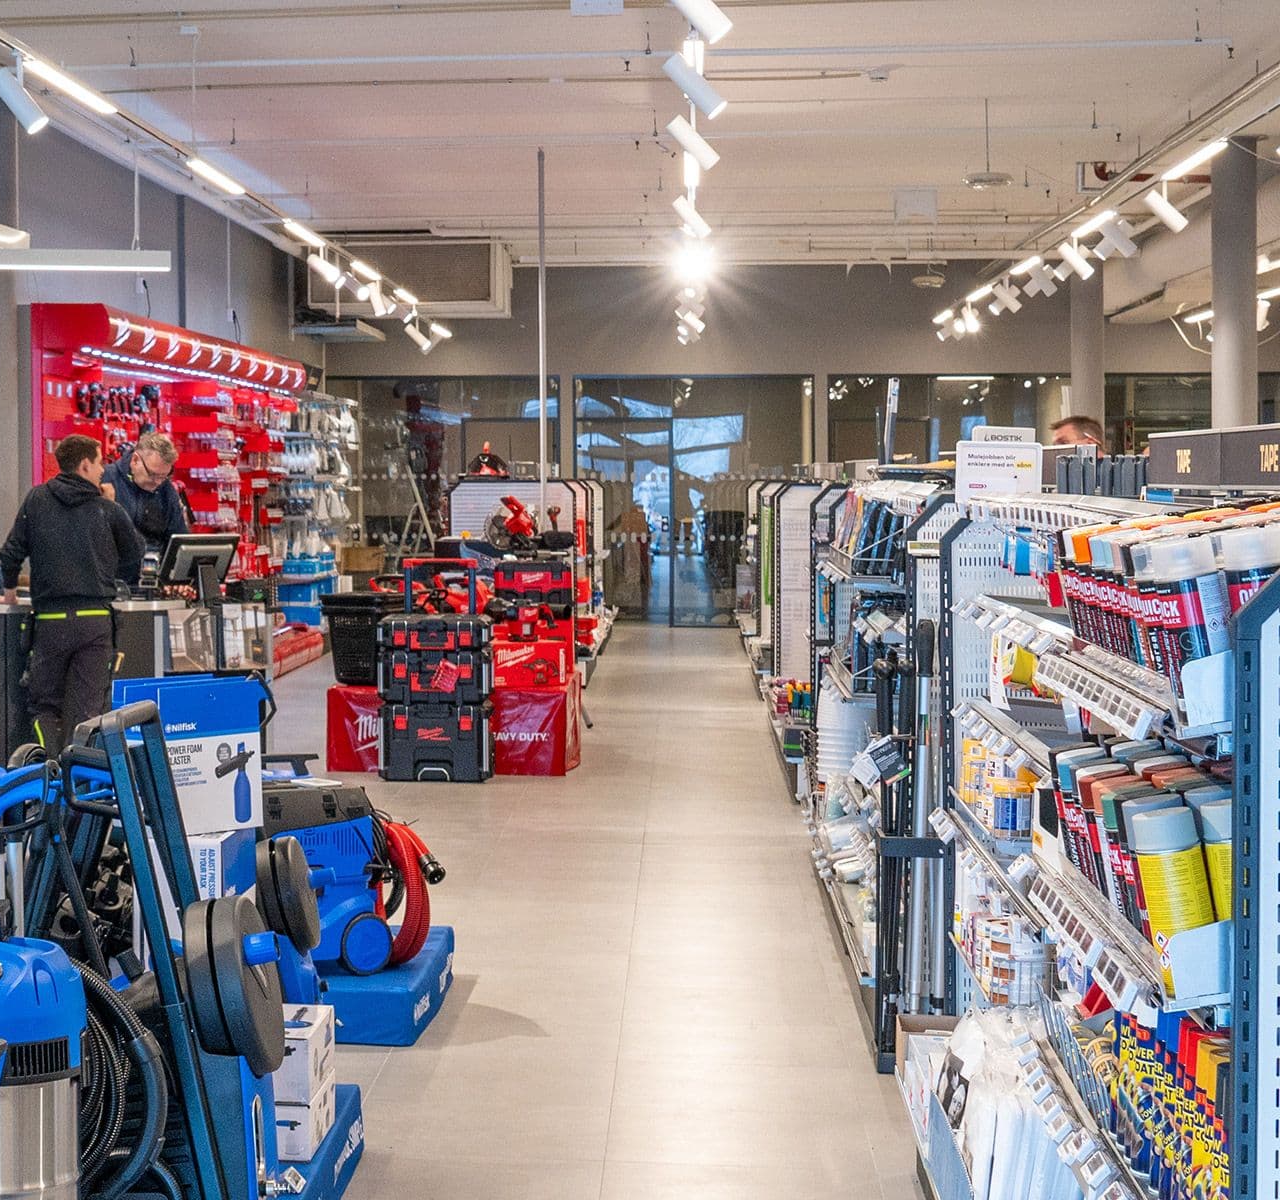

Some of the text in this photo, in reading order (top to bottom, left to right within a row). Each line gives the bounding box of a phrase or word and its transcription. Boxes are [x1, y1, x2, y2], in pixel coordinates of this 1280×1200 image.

[1176, 448, 1191, 473] TAPE
[1259, 443, 1279, 472] TAPE
[187, 743, 203, 755] FOAM
[169, 755, 191, 765] LASTER
